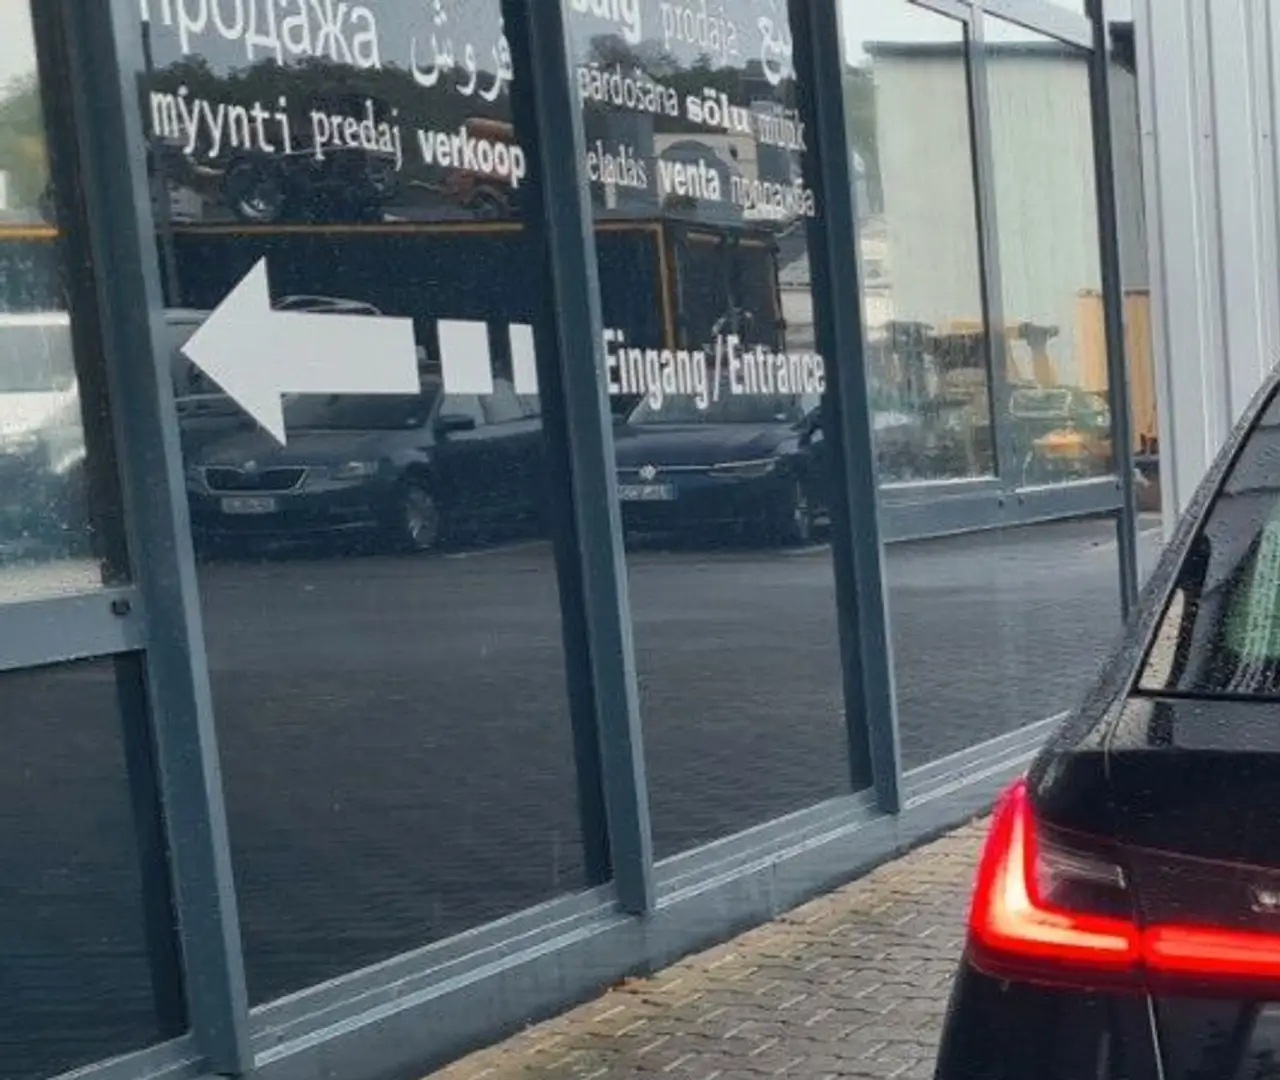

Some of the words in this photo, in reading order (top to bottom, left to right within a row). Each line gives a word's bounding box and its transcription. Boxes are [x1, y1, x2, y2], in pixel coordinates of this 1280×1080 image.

[311, 99, 403, 172] predaj
[418, 125, 526, 189] verkoop
[657, 157, 722, 202] venta
[602, 328, 709, 410] Eingang
[727, 333, 826, 395] Entrance
